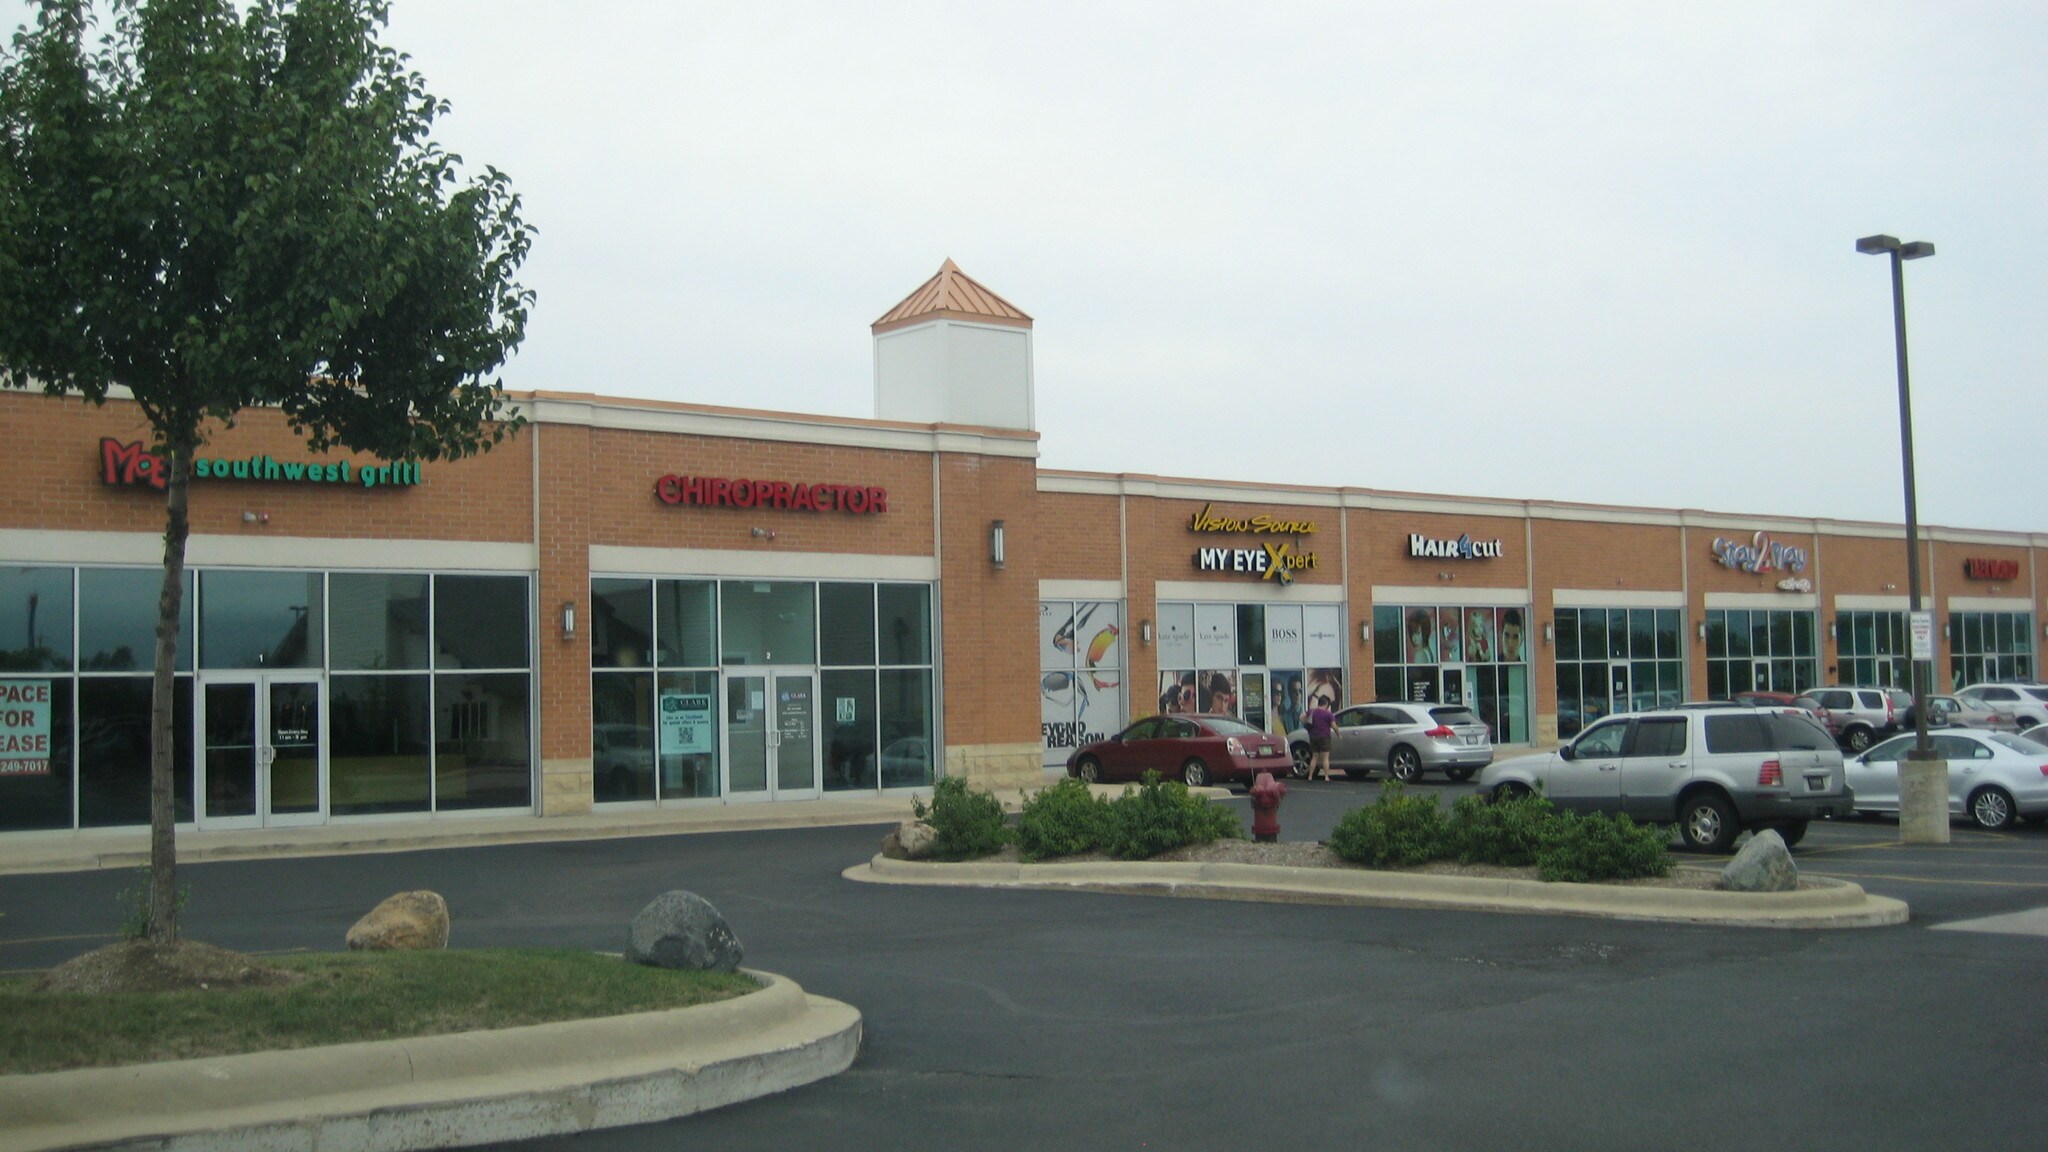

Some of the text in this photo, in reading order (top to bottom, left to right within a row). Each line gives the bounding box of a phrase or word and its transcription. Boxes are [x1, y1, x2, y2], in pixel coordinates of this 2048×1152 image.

[196, 455, 351, 483] southwest
[361, 460, 421, 488] grill
[657, 474, 888, 514] CHIROPRACTOR
[1200, 547, 1229, 571] MY
[1271, 628, 1298, 640] BOSS
